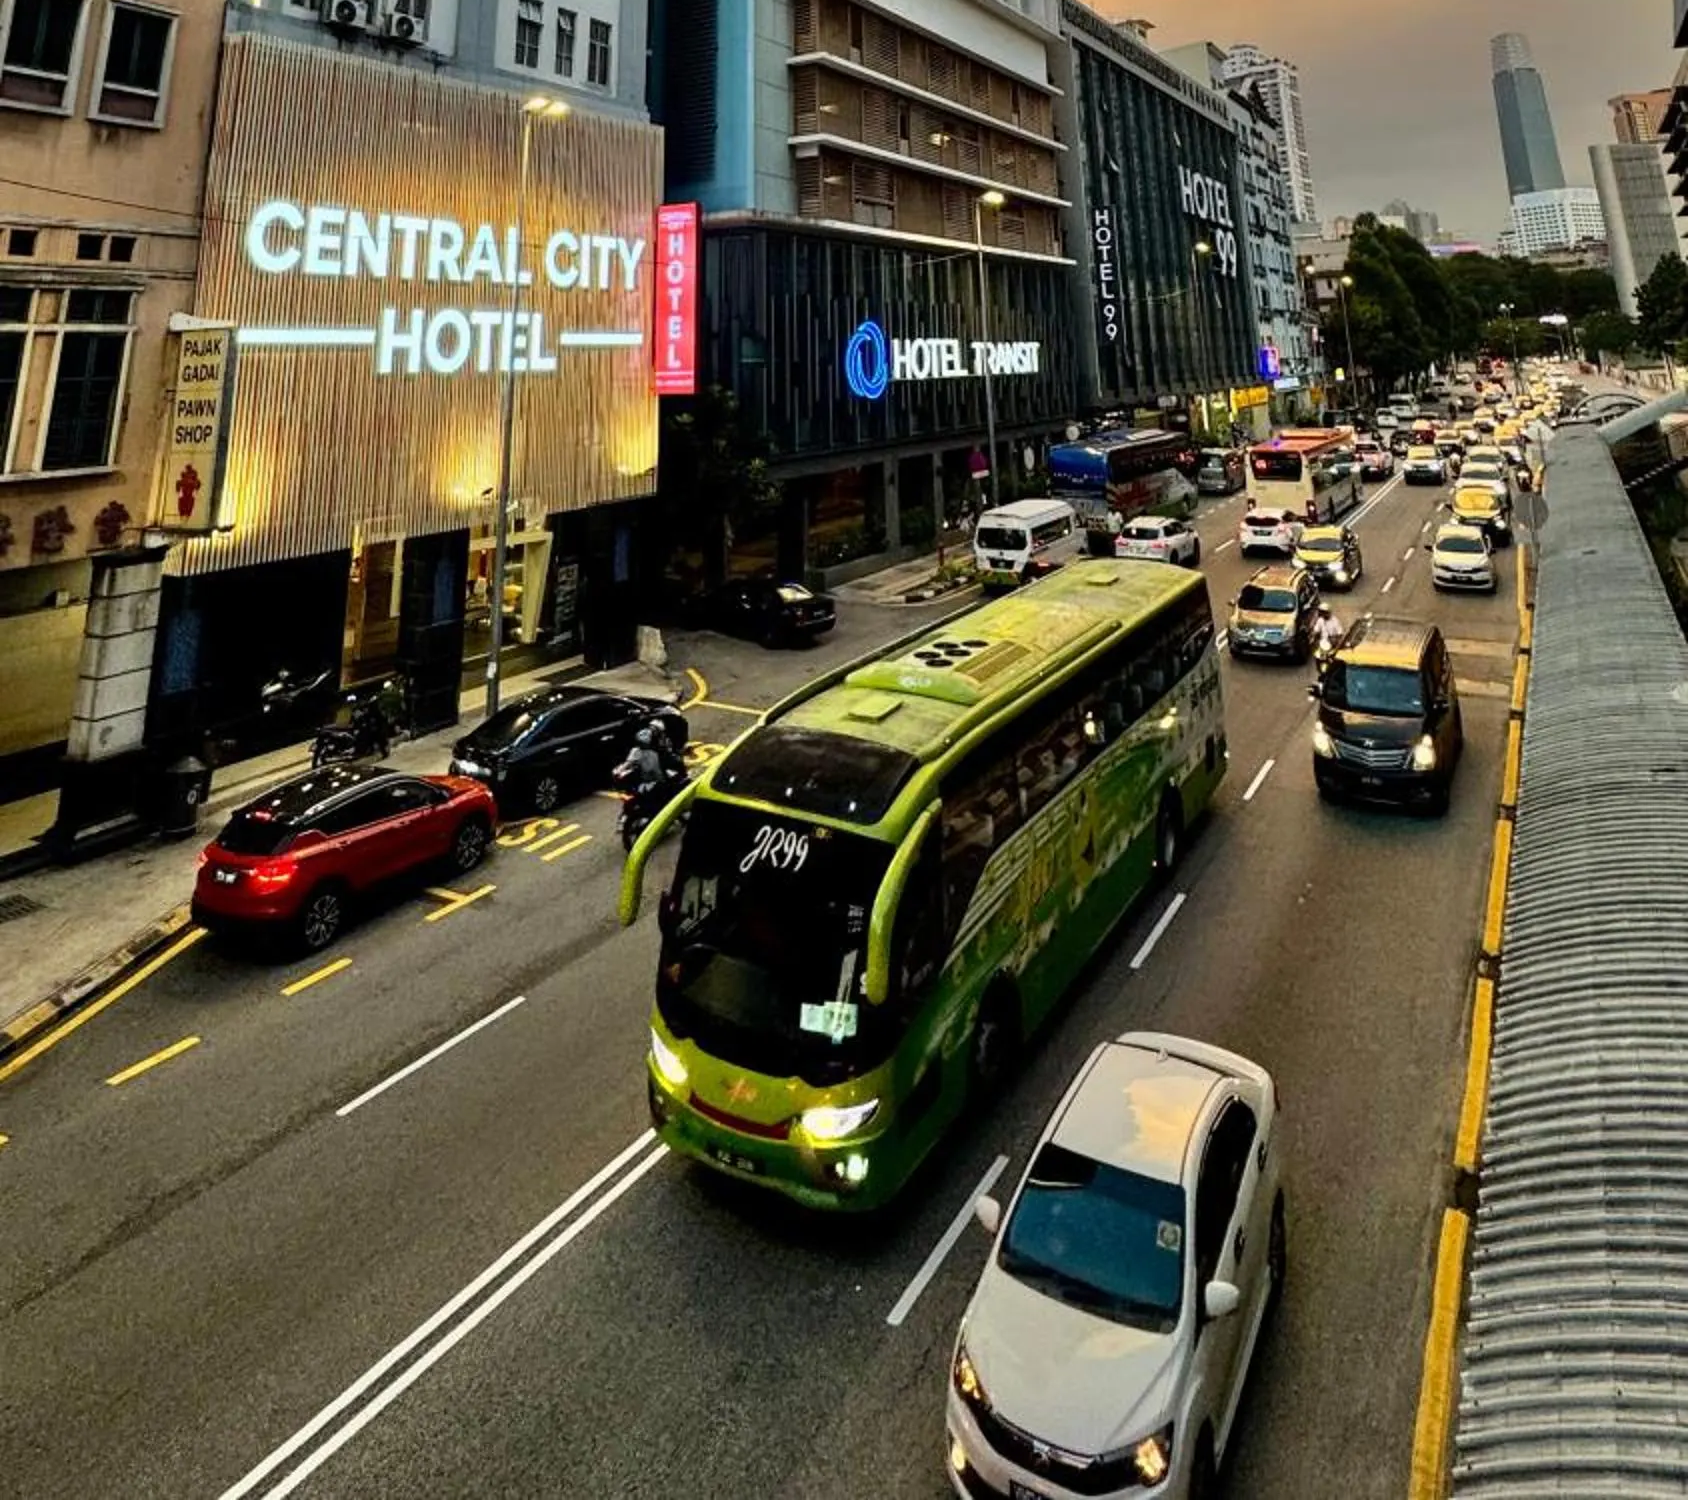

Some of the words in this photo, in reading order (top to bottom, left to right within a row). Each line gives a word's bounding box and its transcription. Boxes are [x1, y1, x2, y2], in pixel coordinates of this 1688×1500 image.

[1178, 165, 1234, 228] HOTEL
[246, 201, 532, 287] CENTRAL
[545, 231, 646, 291] CITY
[1095, 209, 1115, 299] HOTEL
[1215, 229, 1237, 279] 99
[667, 232, 684, 369] HOTEL
[1103, 304, 1118, 341] 99
[183, 339, 222, 357] PAJAK
[376, 307, 557, 374] HOTEL
[891, 337, 969, 380] HOTEL
[970, 341, 1041, 375] TRANSIT
[181, 363, 219, 382] GADAI
[177, 399, 216, 418] PAWN
[175, 426, 213, 444] SHOP
